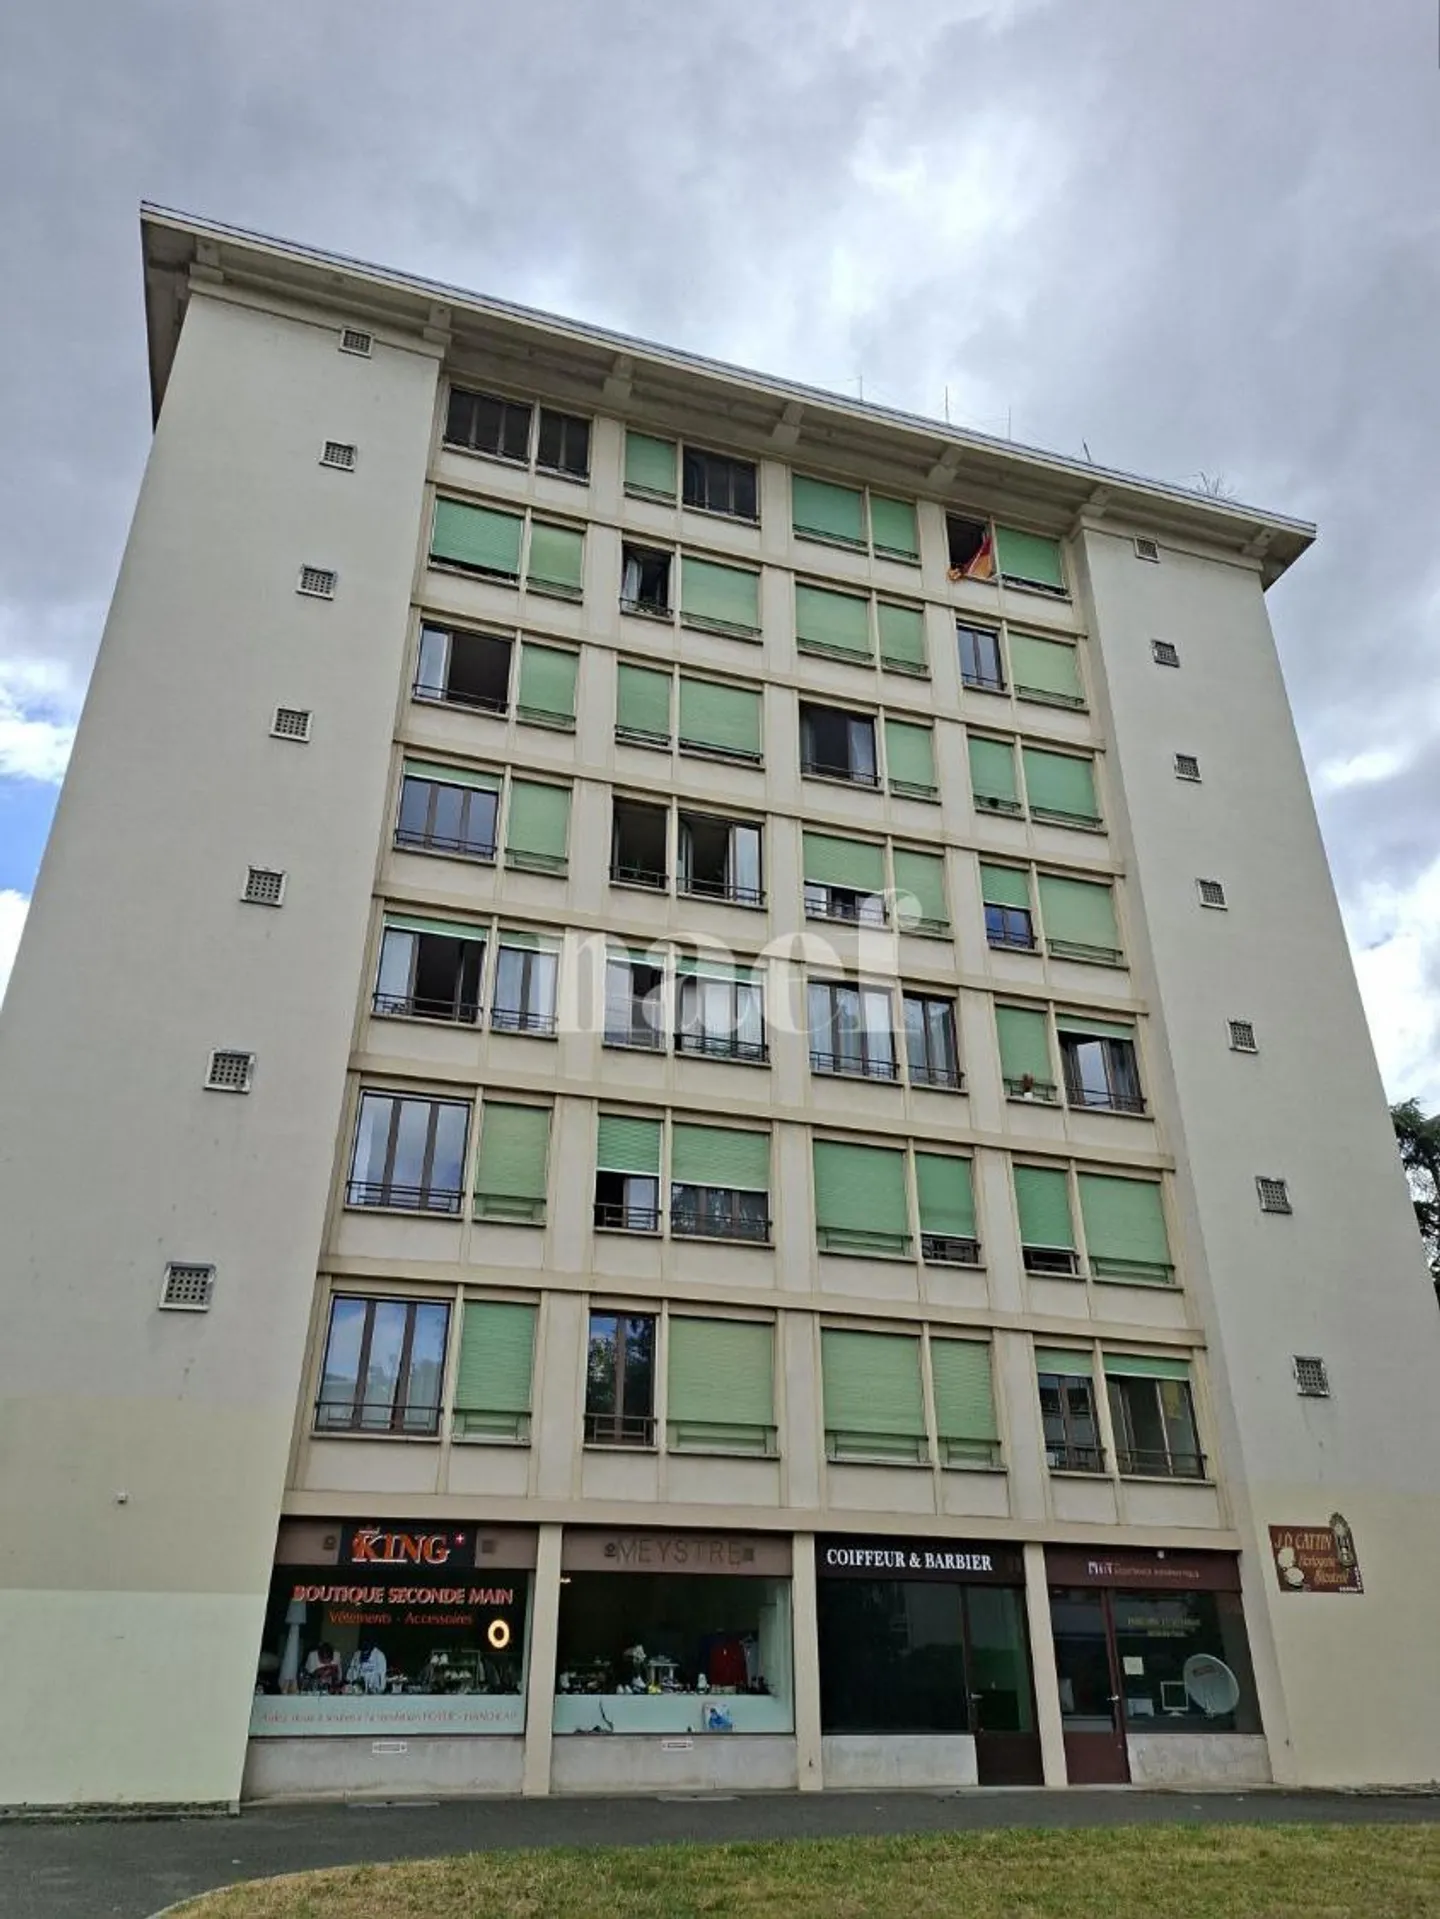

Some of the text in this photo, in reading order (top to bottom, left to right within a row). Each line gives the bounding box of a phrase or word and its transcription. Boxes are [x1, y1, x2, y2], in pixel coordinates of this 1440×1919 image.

[352, 1532, 451, 1564] KING
[616, 1539, 742, 1565] MEYSTRE
[826, 1549, 993, 1571] COIFFEUR & BARBIER
[292, 1585, 514, 1606] BOUTIQUE SECONDE MAIN
[328, 1611, 392, 1625] Vêtements
[404, 1612, 473, 1625] Accessoires
